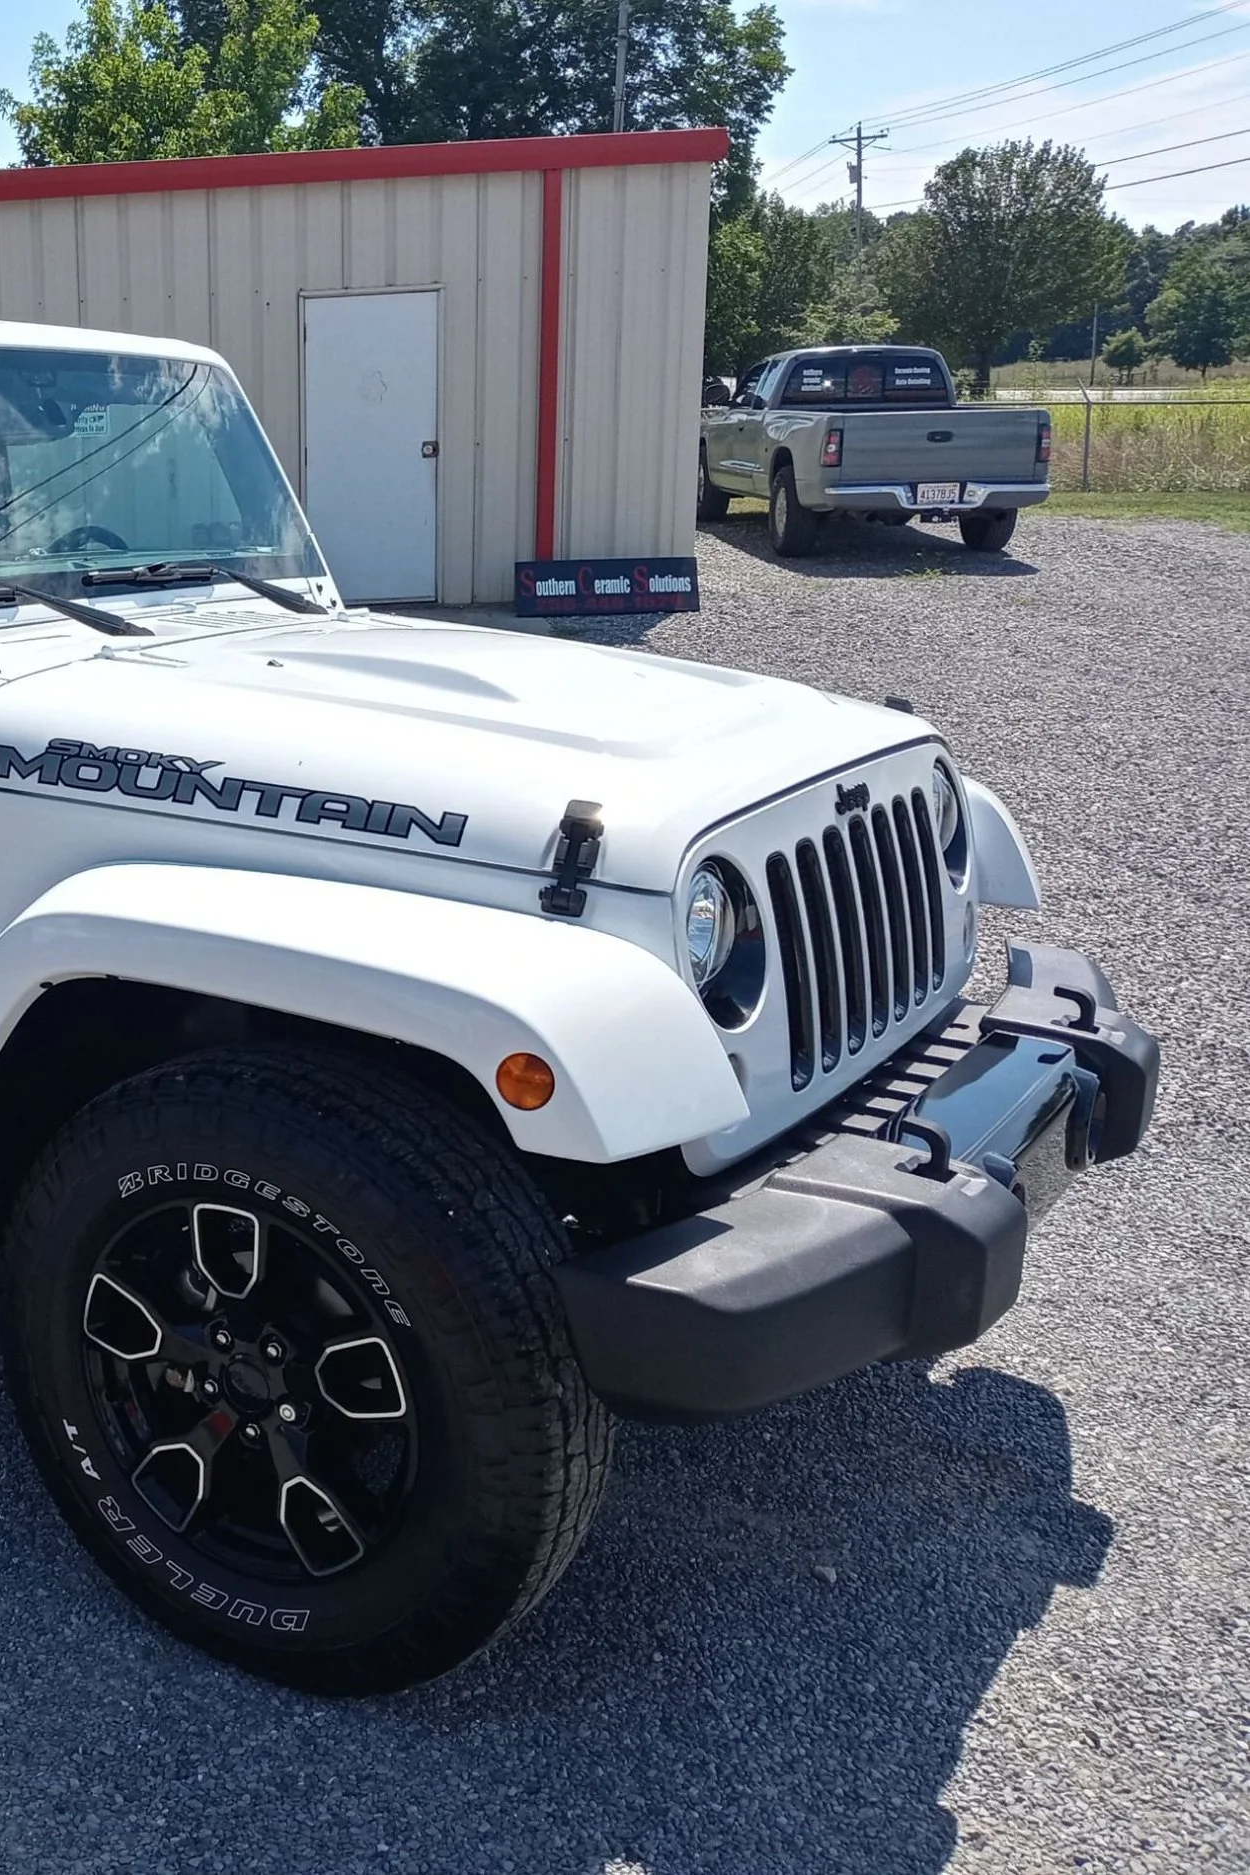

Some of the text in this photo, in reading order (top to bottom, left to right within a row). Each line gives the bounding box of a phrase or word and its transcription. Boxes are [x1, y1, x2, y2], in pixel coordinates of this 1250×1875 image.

[519, 565, 692, 597] Southern Ceramic Solutions
[47, 738, 226, 773] SMOKY
[117, 1162, 411, 1328] BRIDGESTONE
[62, 1417, 311, 1633] DUELER A/T
